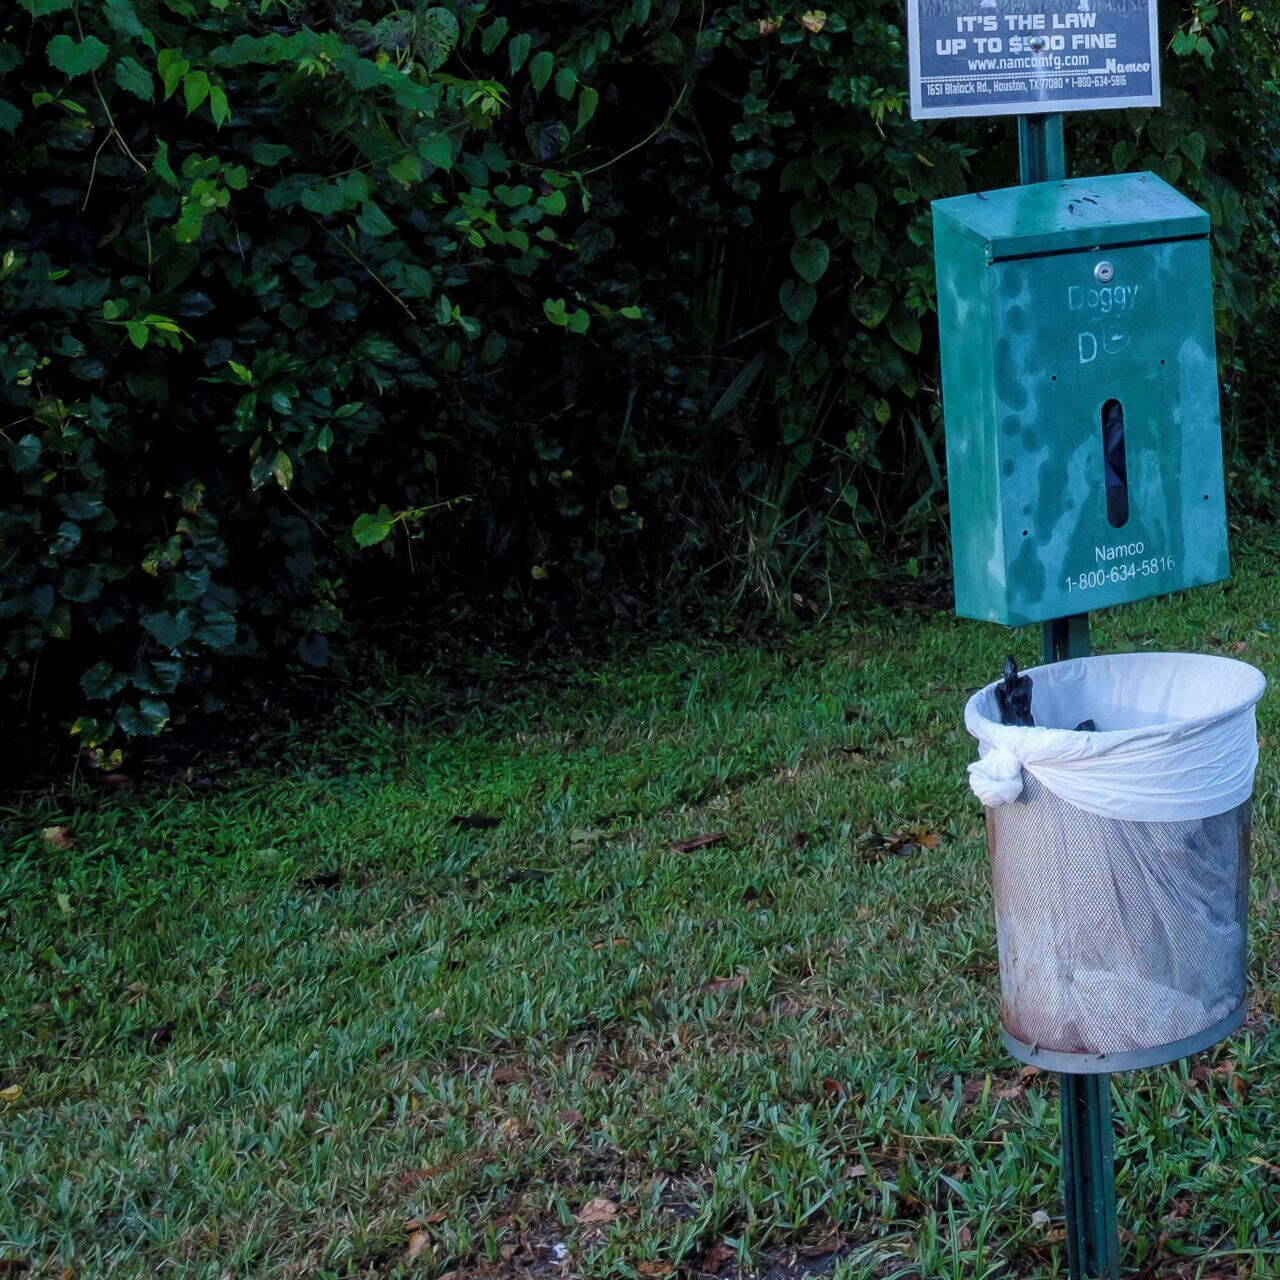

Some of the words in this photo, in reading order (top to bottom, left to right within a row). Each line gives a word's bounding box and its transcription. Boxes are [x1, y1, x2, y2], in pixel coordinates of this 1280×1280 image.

[956, 15, 998, 33] IT'S
[1004, 13, 1046, 31] THE
[1052, 12, 1097, 29] LAW
[935, 38, 967, 56] UP
[973, 36, 1003, 54] TO
[1071, 33, 1117, 50] FINE
[967, 53, 1090, 71] www.namcomfg.com
[1105, 58, 1151, 74] Namco
[926, 83, 944, 96] 1651
[945, 81, 975, 95] Blalock
[993, 79, 1028, 93] Houston,
[1029, 78, 1040, 91] TX
[1040, 76, 1064, 91] 77080
[1071, 75, 1127, 89] 1-800-634-5816
[1094, 541, 1145, 563] Namco
[1065, 554, 1176, 593] 1-800-634-5816
